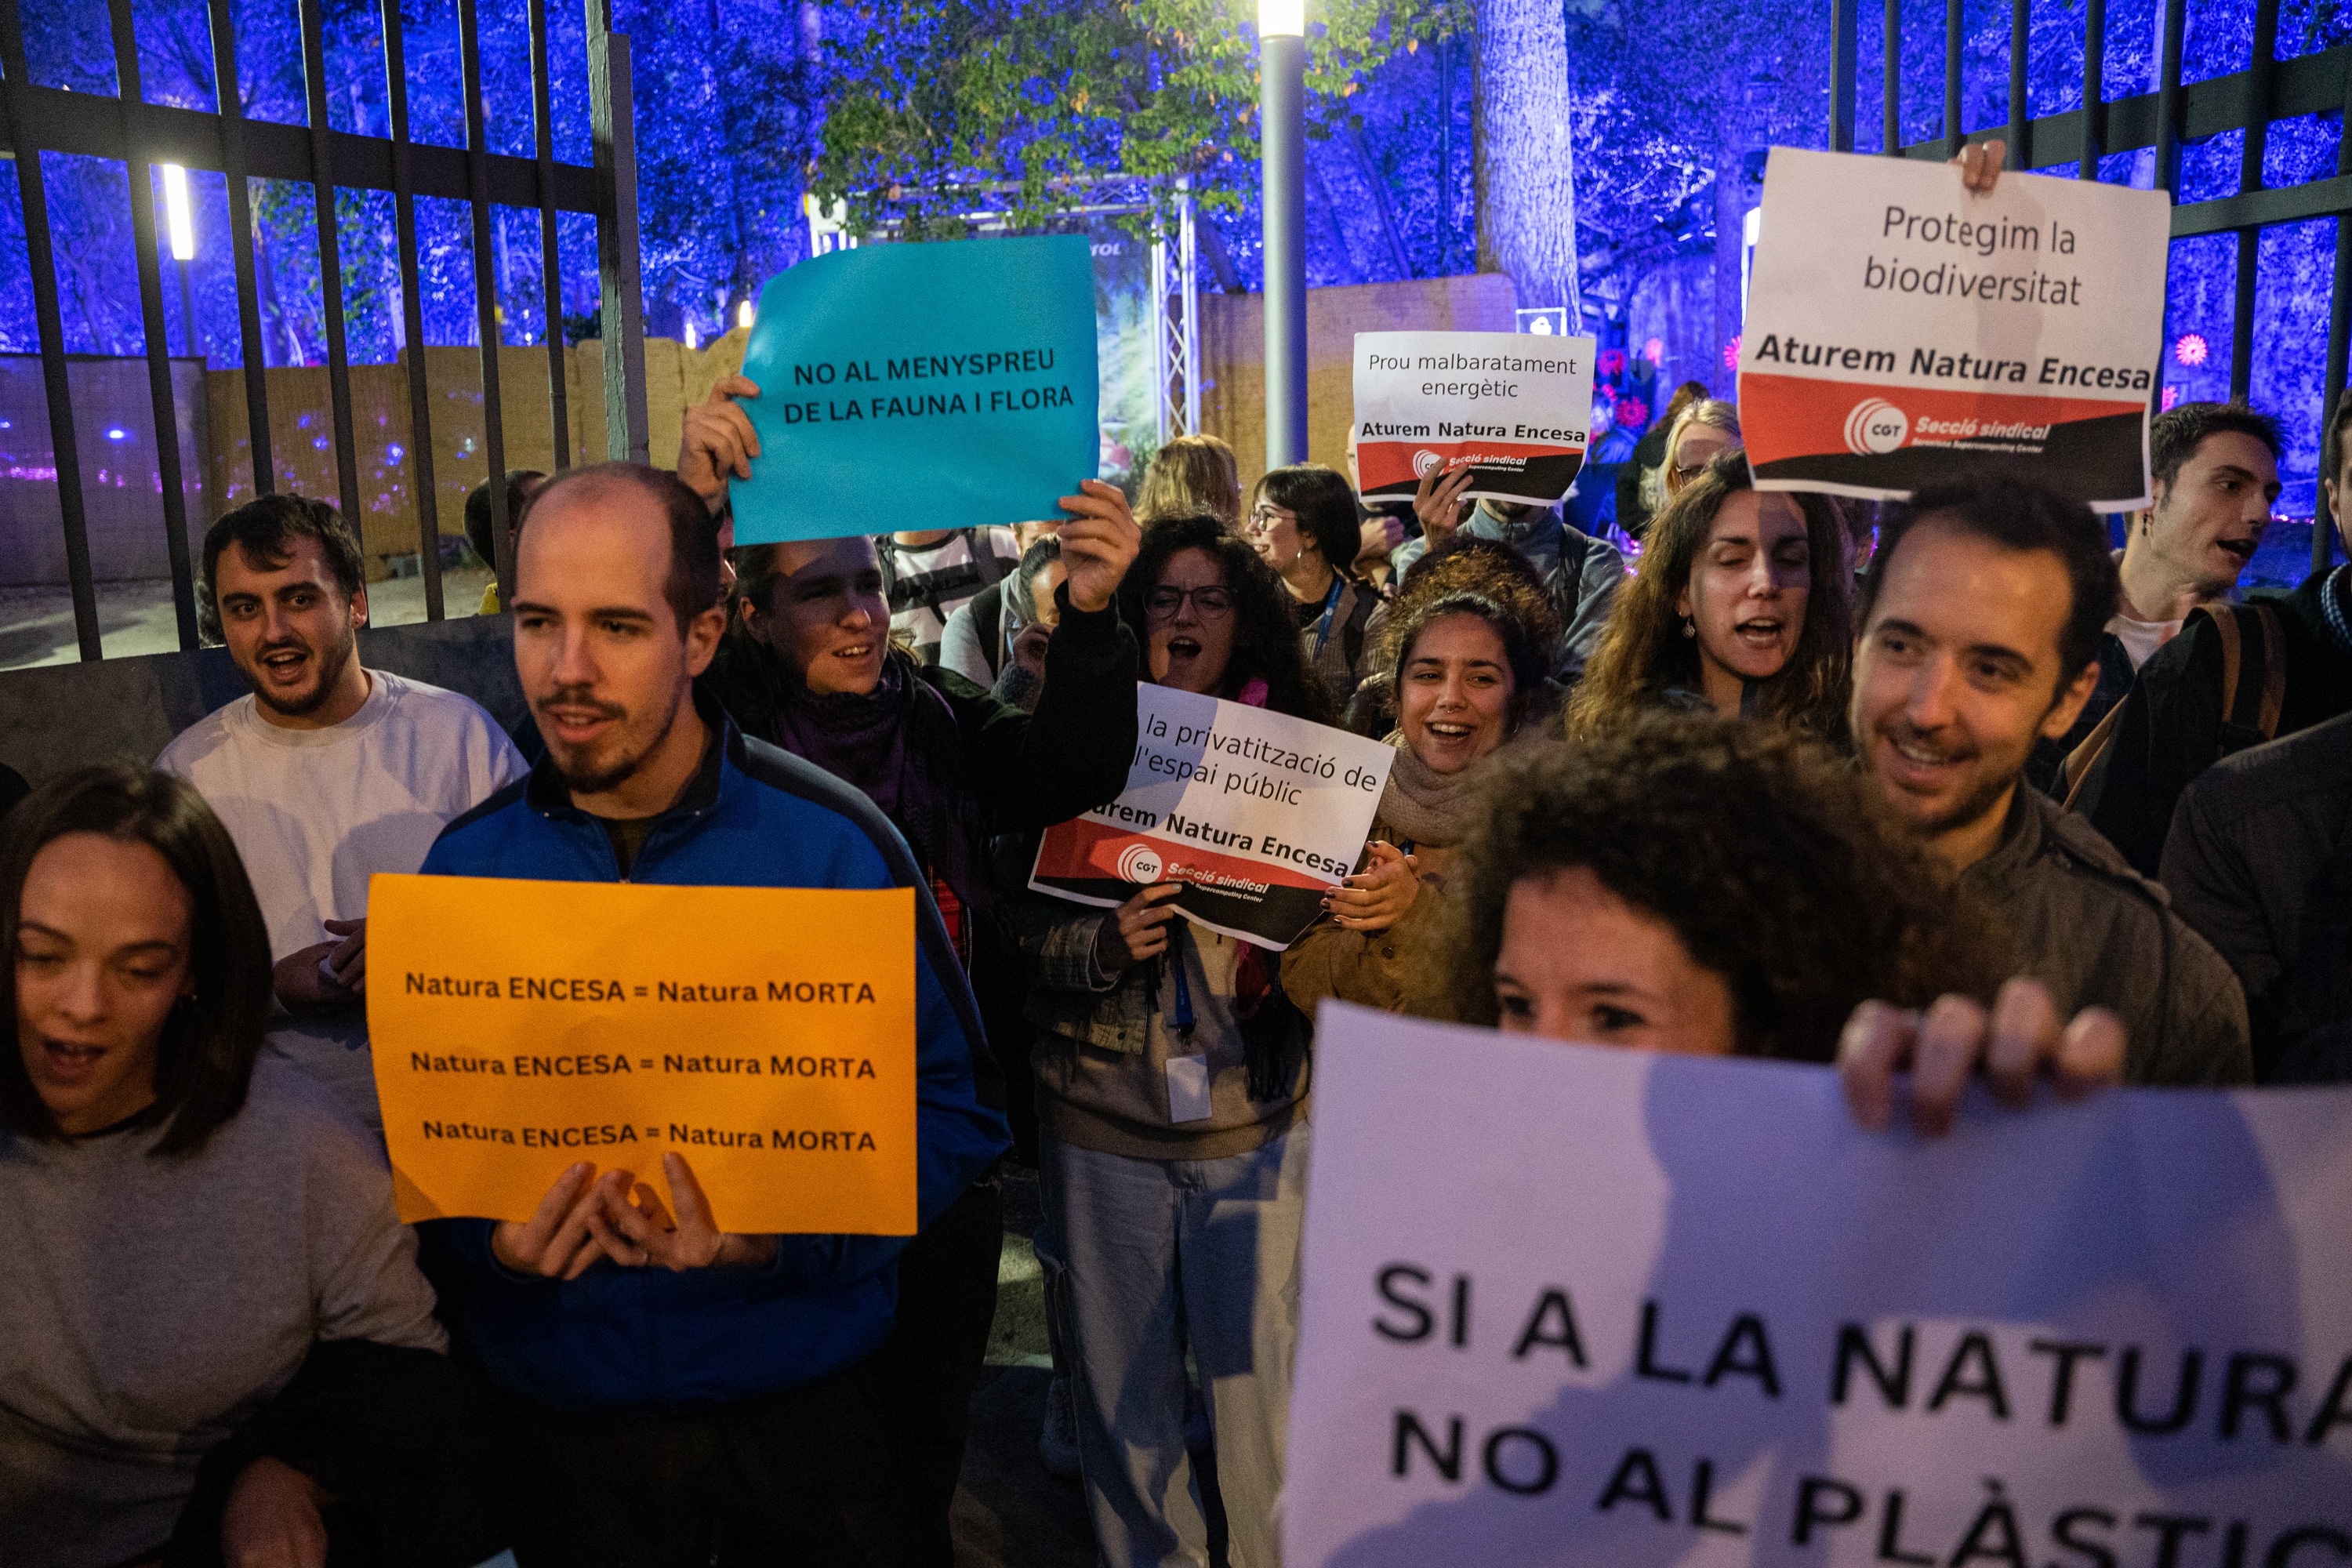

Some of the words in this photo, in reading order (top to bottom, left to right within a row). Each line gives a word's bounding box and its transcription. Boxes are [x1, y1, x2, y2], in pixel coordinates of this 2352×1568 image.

[1883, 205, 2039, 256] Protegim
[2052, 220, 2076, 255] la
[1864, 256, 2082, 307] biodiversitat
[794, 362, 835, 386] NO
[845, 361, 879, 383] AL
[887, 348, 1054, 380] MENYSPREU
[1369, 354, 1410, 371] Prou
[1418, 354, 1576, 375] malbaratament
[1756, 334, 1896, 373] Aturem
[1910, 348, 2027, 383] Natura
[2038, 358, 2151, 390] Encesa
[785, 402, 821, 424] DE
[829, 400, 863, 422] LA
[872, 394, 966, 419] FAUNA
[975, 393, 981, 412] I
[991, 386, 1073, 412] FLORA
[1421, 379, 1518, 400] energètic
[1362, 423, 1430, 437] Aturem
[1439, 423, 1506, 437] Natura
[1515, 424, 1585, 442] Encesa
[1871, 424, 1901, 437] CGT
[1915, 416, 1978, 436] Secció
[1979, 421, 2051, 440] sindical
[1449, 454, 1482, 466] Secció
[1483, 455, 1527, 466] sindical
[1146, 713, 1167, 738] la
[1175, 725, 1335, 779] privatització
[1345, 765, 1377, 793] de
[1134, 746, 1216, 785] l'espai
[1224, 771, 1302, 806] públic
[1092, 801, 1157, 828] urem
[1165, 813, 1253, 851] Natura
[1261, 837, 1349, 878] Encesa
[1136, 862, 1158, 873] CGT
[1167, 862, 1217, 883] Secció
[1216, 874, 1269, 895] sindical
[1195, 883, 1243, 899] Supercomputing
[1243, 894, 1263, 903] Center
[406, 972, 500, 998] Natura
[510, 977, 625, 1001] ENCESA
[634, 985, 648, 997] =
[659, 982, 758, 1003] Natura
[768, 982, 875, 1004] MORTA
[411, 1052, 506, 1075] Natura
[514, 1054, 631, 1076] ENCESA
[640, 1059, 654, 1069] =
[664, 1054, 761, 1075] Natura
[771, 1055, 876, 1079] MORTA
[423, 1120, 515, 1144] Natura
[523, 1124, 638, 1147] ENCESA
[646, 1127, 660, 1138] =
[670, 1123, 763, 1148] Natura
[772, 1130, 876, 1152] MORTA
[1373, 1263, 1471, 1348] SI
[1512, 1287, 1592, 1368] A
[1635, 1298, 1784, 1400] LA
[1391, 1410, 1560, 1497] NO
[1596, 1446, 1746, 1535] AL
